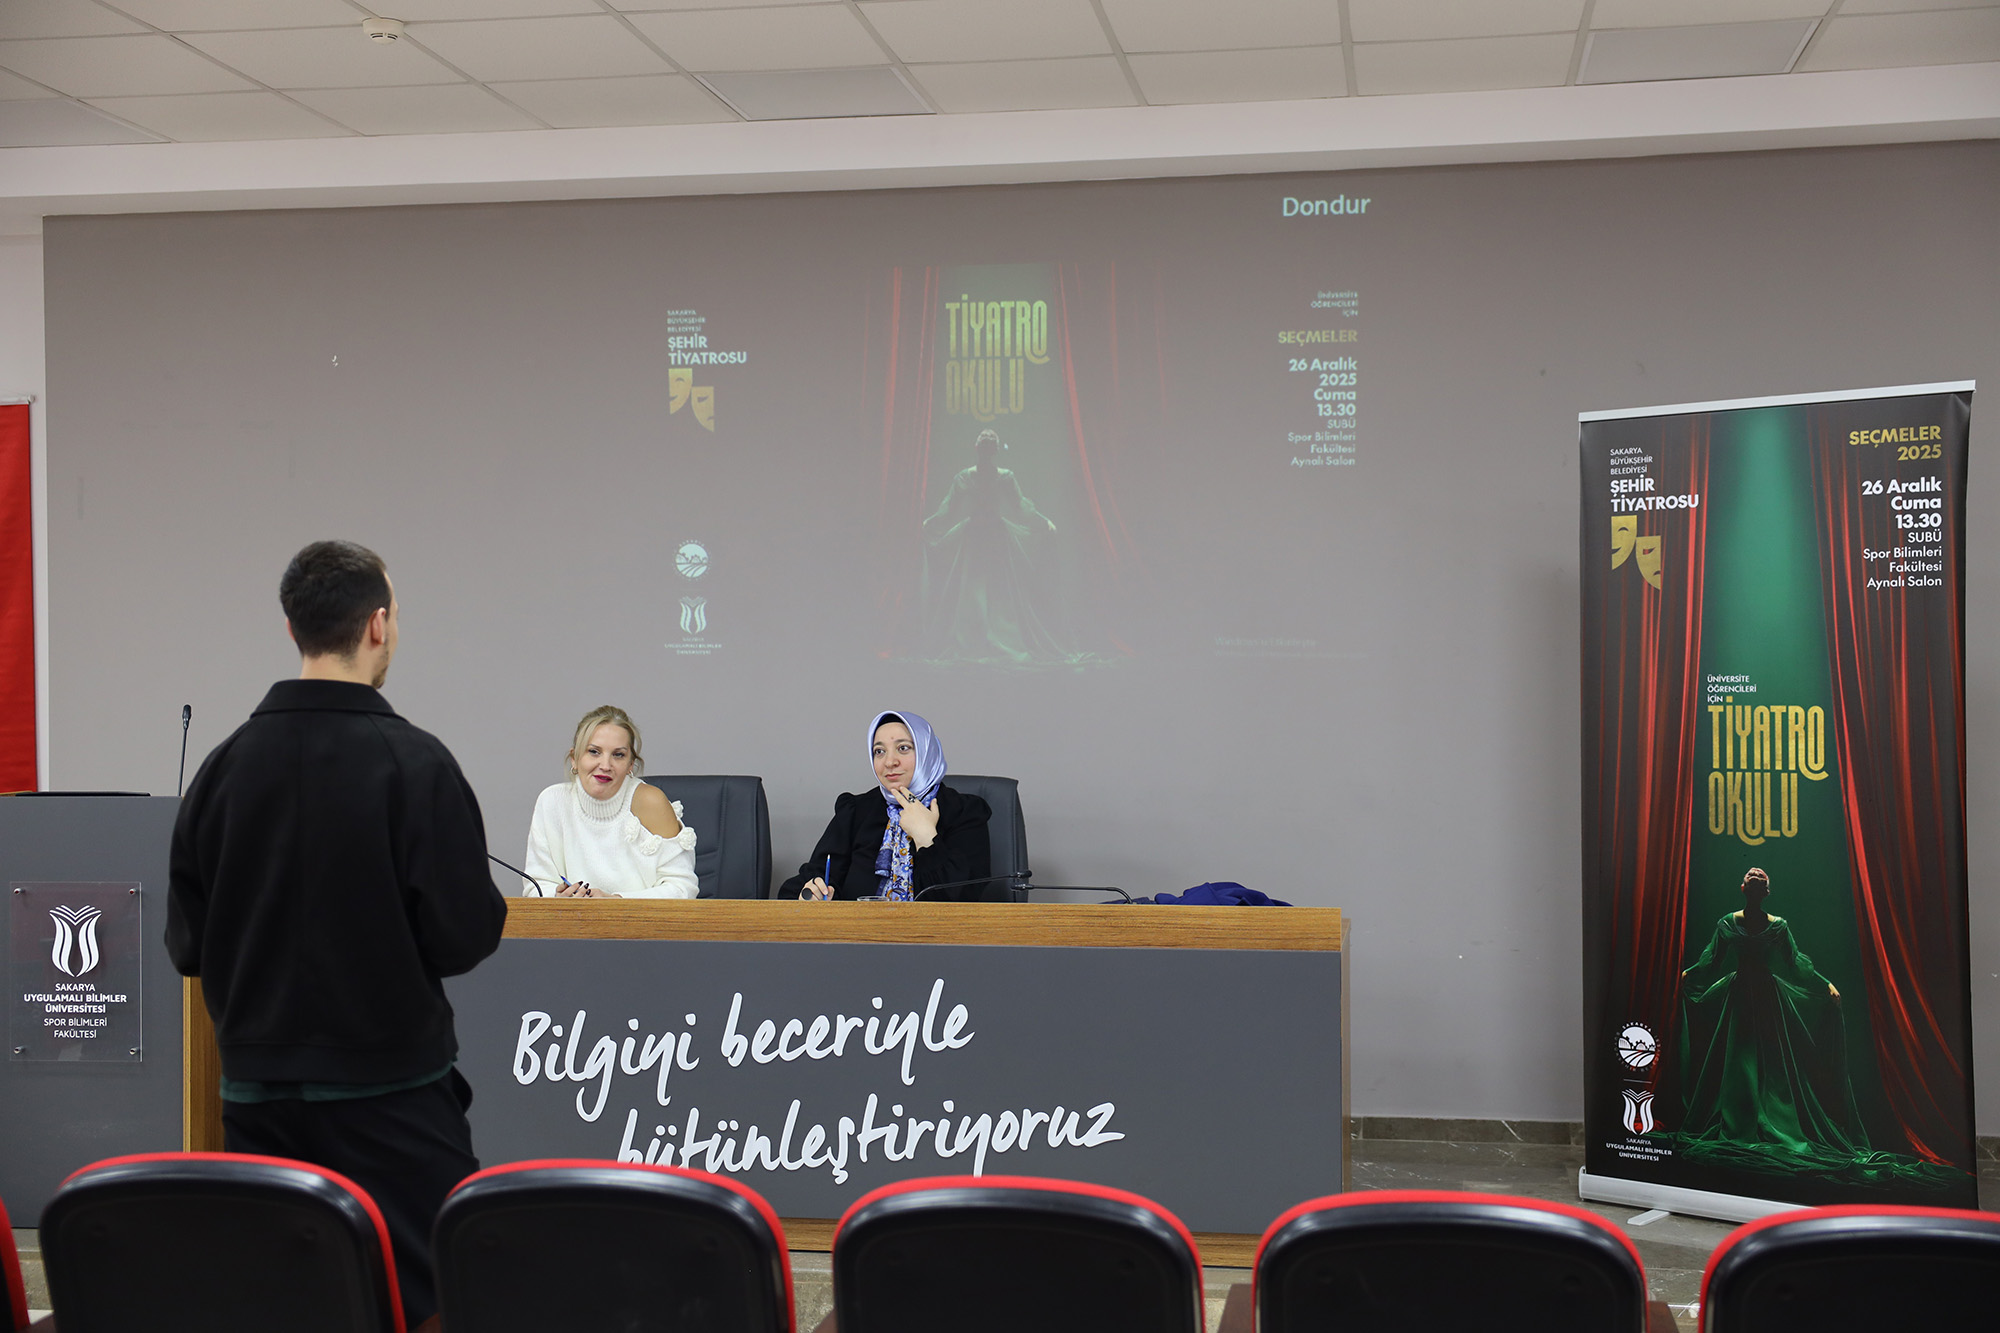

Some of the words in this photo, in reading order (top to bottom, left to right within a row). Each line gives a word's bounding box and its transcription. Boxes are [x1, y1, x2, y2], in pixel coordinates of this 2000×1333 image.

[1283, 194, 1371, 217] Dondur
[945, 293, 1050, 365] TİYATRO
[667, 333, 708, 351] ŞEHİR
[1278, 329, 1358, 347] SEÇMELER
[668, 350, 747, 365] TİYATROSU
[1289, 358, 1308, 372] 26
[1310, 356, 1358, 371] Aralık
[1319, 373, 1358, 386] 2025
[945, 358, 1025, 423] OKULU
[1313, 388, 1357, 401] Cuma
[1316, 403, 1357, 416] 13.30
[1327, 417, 1356, 429] SUBÜ
[1288, 432, 1312, 444] Spor
[1315, 431, 1356, 441] Bilimleri
[1849, 425, 1942, 448] SEÇMELER
[1310, 443, 1356, 454] Fakültesi
[1610, 447, 1642, 455] SAKARYA
[1897, 444, 1942, 461] 2025
[1290, 456, 1324, 468] Aynalı
[1326, 455, 1356, 466] Salon
[1610, 455, 1653, 466] BÜYÜKŞEHİR
[1610, 465, 1648, 475] BELEDİYESİ
[1610, 474, 1655, 497] ŞEHİR
[1861, 479, 1884, 496] 26
[1886, 476, 1942, 494] Aralık
[1610, 494, 1699, 512] TİYATROSU
[1890, 496, 1942, 510] Cuma
[1894, 512, 1942, 529] 13.30
[1907, 529, 1942, 543] SUBÜ
[1863, 548, 1891, 562] Spor
[1893, 546, 1942, 559] Bilimleri
[1889, 561, 1942, 573] Fakültesi
[1866, 576, 1905, 591] Aynalı
[1907, 575, 1942, 587] Salon
[1707, 673, 1750, 683] ÜNİVERSİTE
[1707, 684, 1757, 693] ÖĞRENCİLERİ
[1707, 694, 1724, 704] İÇİN
[1707, 695, 1830, 782] TİYATRO
[1708, 771, 1799, 847] OKULU
[55, 983, 96, 992] SAKARYA
[23, 993, 84, 1003] UYGULAMALI
[86, 993, 128, 1003] BİLİMLER
[45, 1003, 106, 1014] ÜNİVERSİTESİ
[43, 1018, 67, 1027] SPOR
[68, 1017, 108, 1027] BİLİMLERİ
[53, 1029, 97, 1039] FAKÜLTESİ
[513, 1010, 700, 1123] Bilgiyi
[720, 978, 975, 1086] beceriyle
[1605, 1142, 1644, 1152] UYGULAMALI
[1625, 1137, 1652, 1146] SAKARYA
